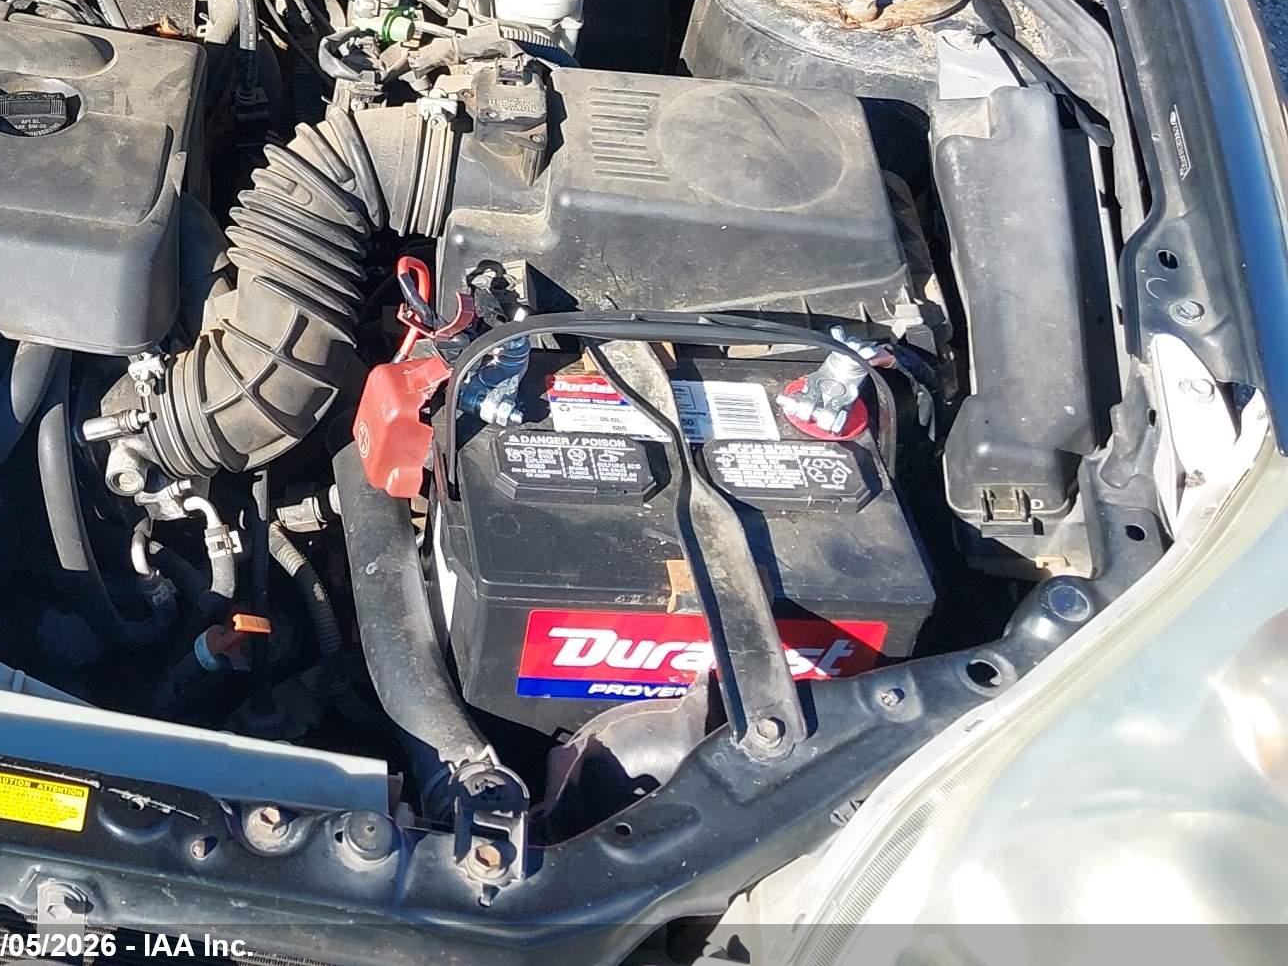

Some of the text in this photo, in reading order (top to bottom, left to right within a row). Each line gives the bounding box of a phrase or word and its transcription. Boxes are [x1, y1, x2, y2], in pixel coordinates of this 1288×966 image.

[520, 435, 570, 446] DANGER
[581, 438, 627, 448] POISON
[547, 626, 856, 677] Durast
[36, 781, 85, 799] ATTENTION
